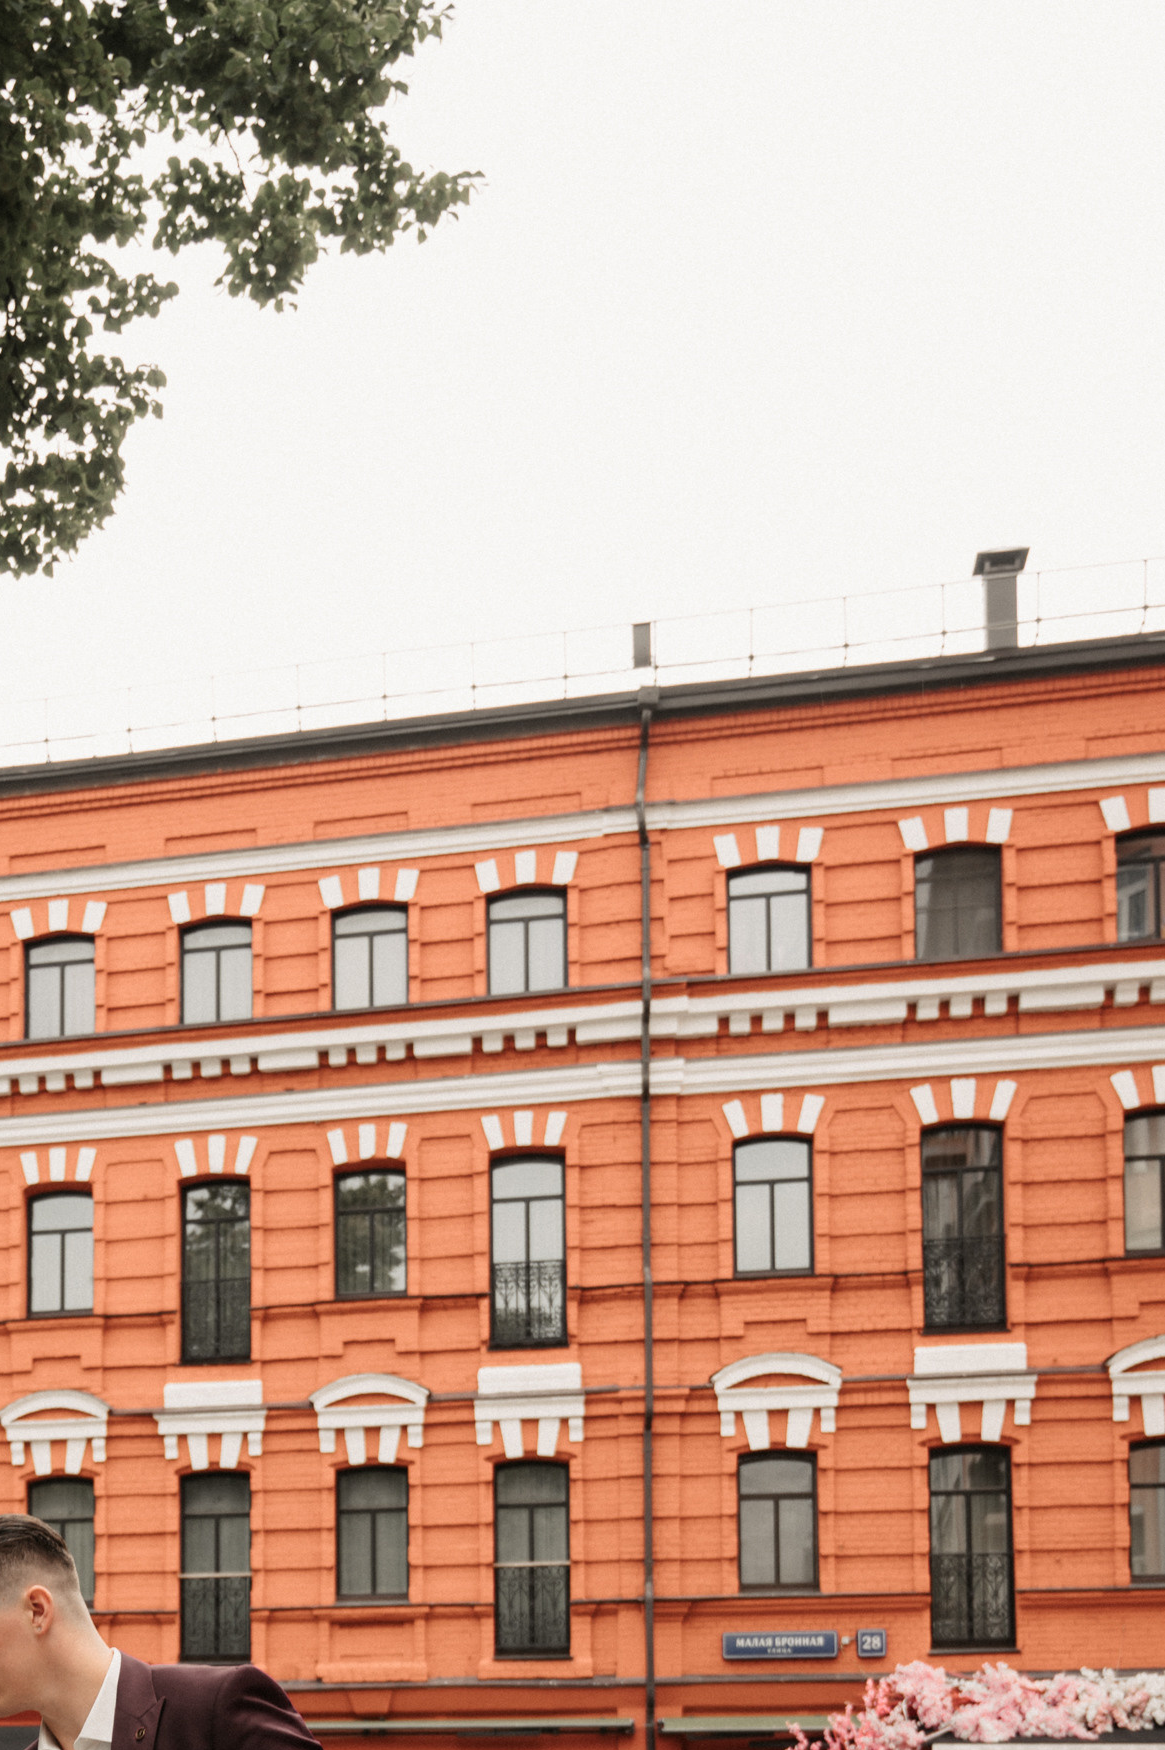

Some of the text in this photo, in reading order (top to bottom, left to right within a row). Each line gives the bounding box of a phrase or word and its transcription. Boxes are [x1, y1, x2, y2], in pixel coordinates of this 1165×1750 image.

[736, 1636, 824, 1648] МАЛАЯ БРОННАЯ
[861, 1635, 881, 1650] 28
